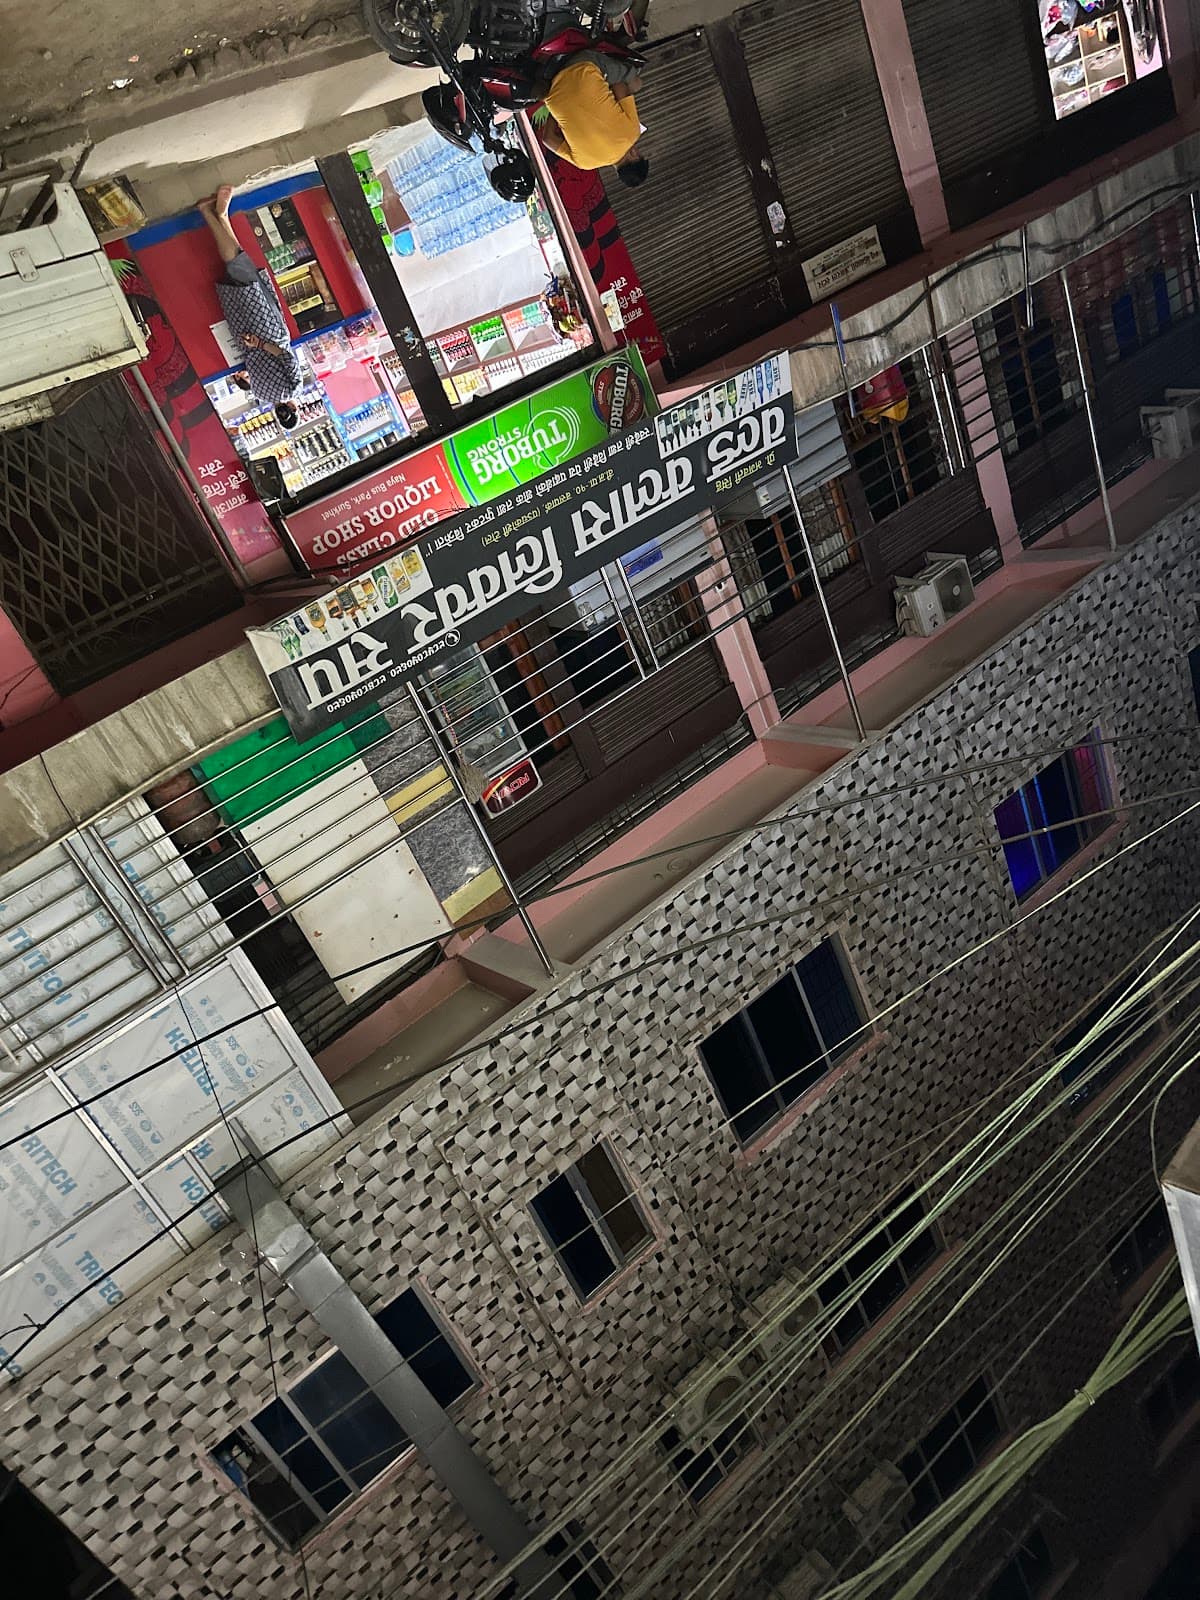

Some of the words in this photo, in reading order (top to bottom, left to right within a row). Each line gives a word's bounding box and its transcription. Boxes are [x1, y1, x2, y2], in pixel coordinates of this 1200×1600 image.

[609, 365, 628, 428] TUBORG
[466, 426, 520, 461] STRONG
[470, 418, 567, 485] TUBORG
[370, 482, 386, 495] Bus
[385, 472, 405, 487] Naya
[734, 459, 762, 484] भगवती
[320, 500, 350, 520] Surkhet
[350, 489, 370, 505] Park,
[361, 475, 441, 527] LIQUOR
[569, 458, 695, 556] क्लास
[309, 515, 362, 556] SHOP
[396, 507, 439, 541] OLD
[334, 530, 395, 573] CLASS
[297, 632, 392, 709] सप
[164, 1026, 220, 1096] TRITECH
[20, 1125, 77, 1196] RITECH
